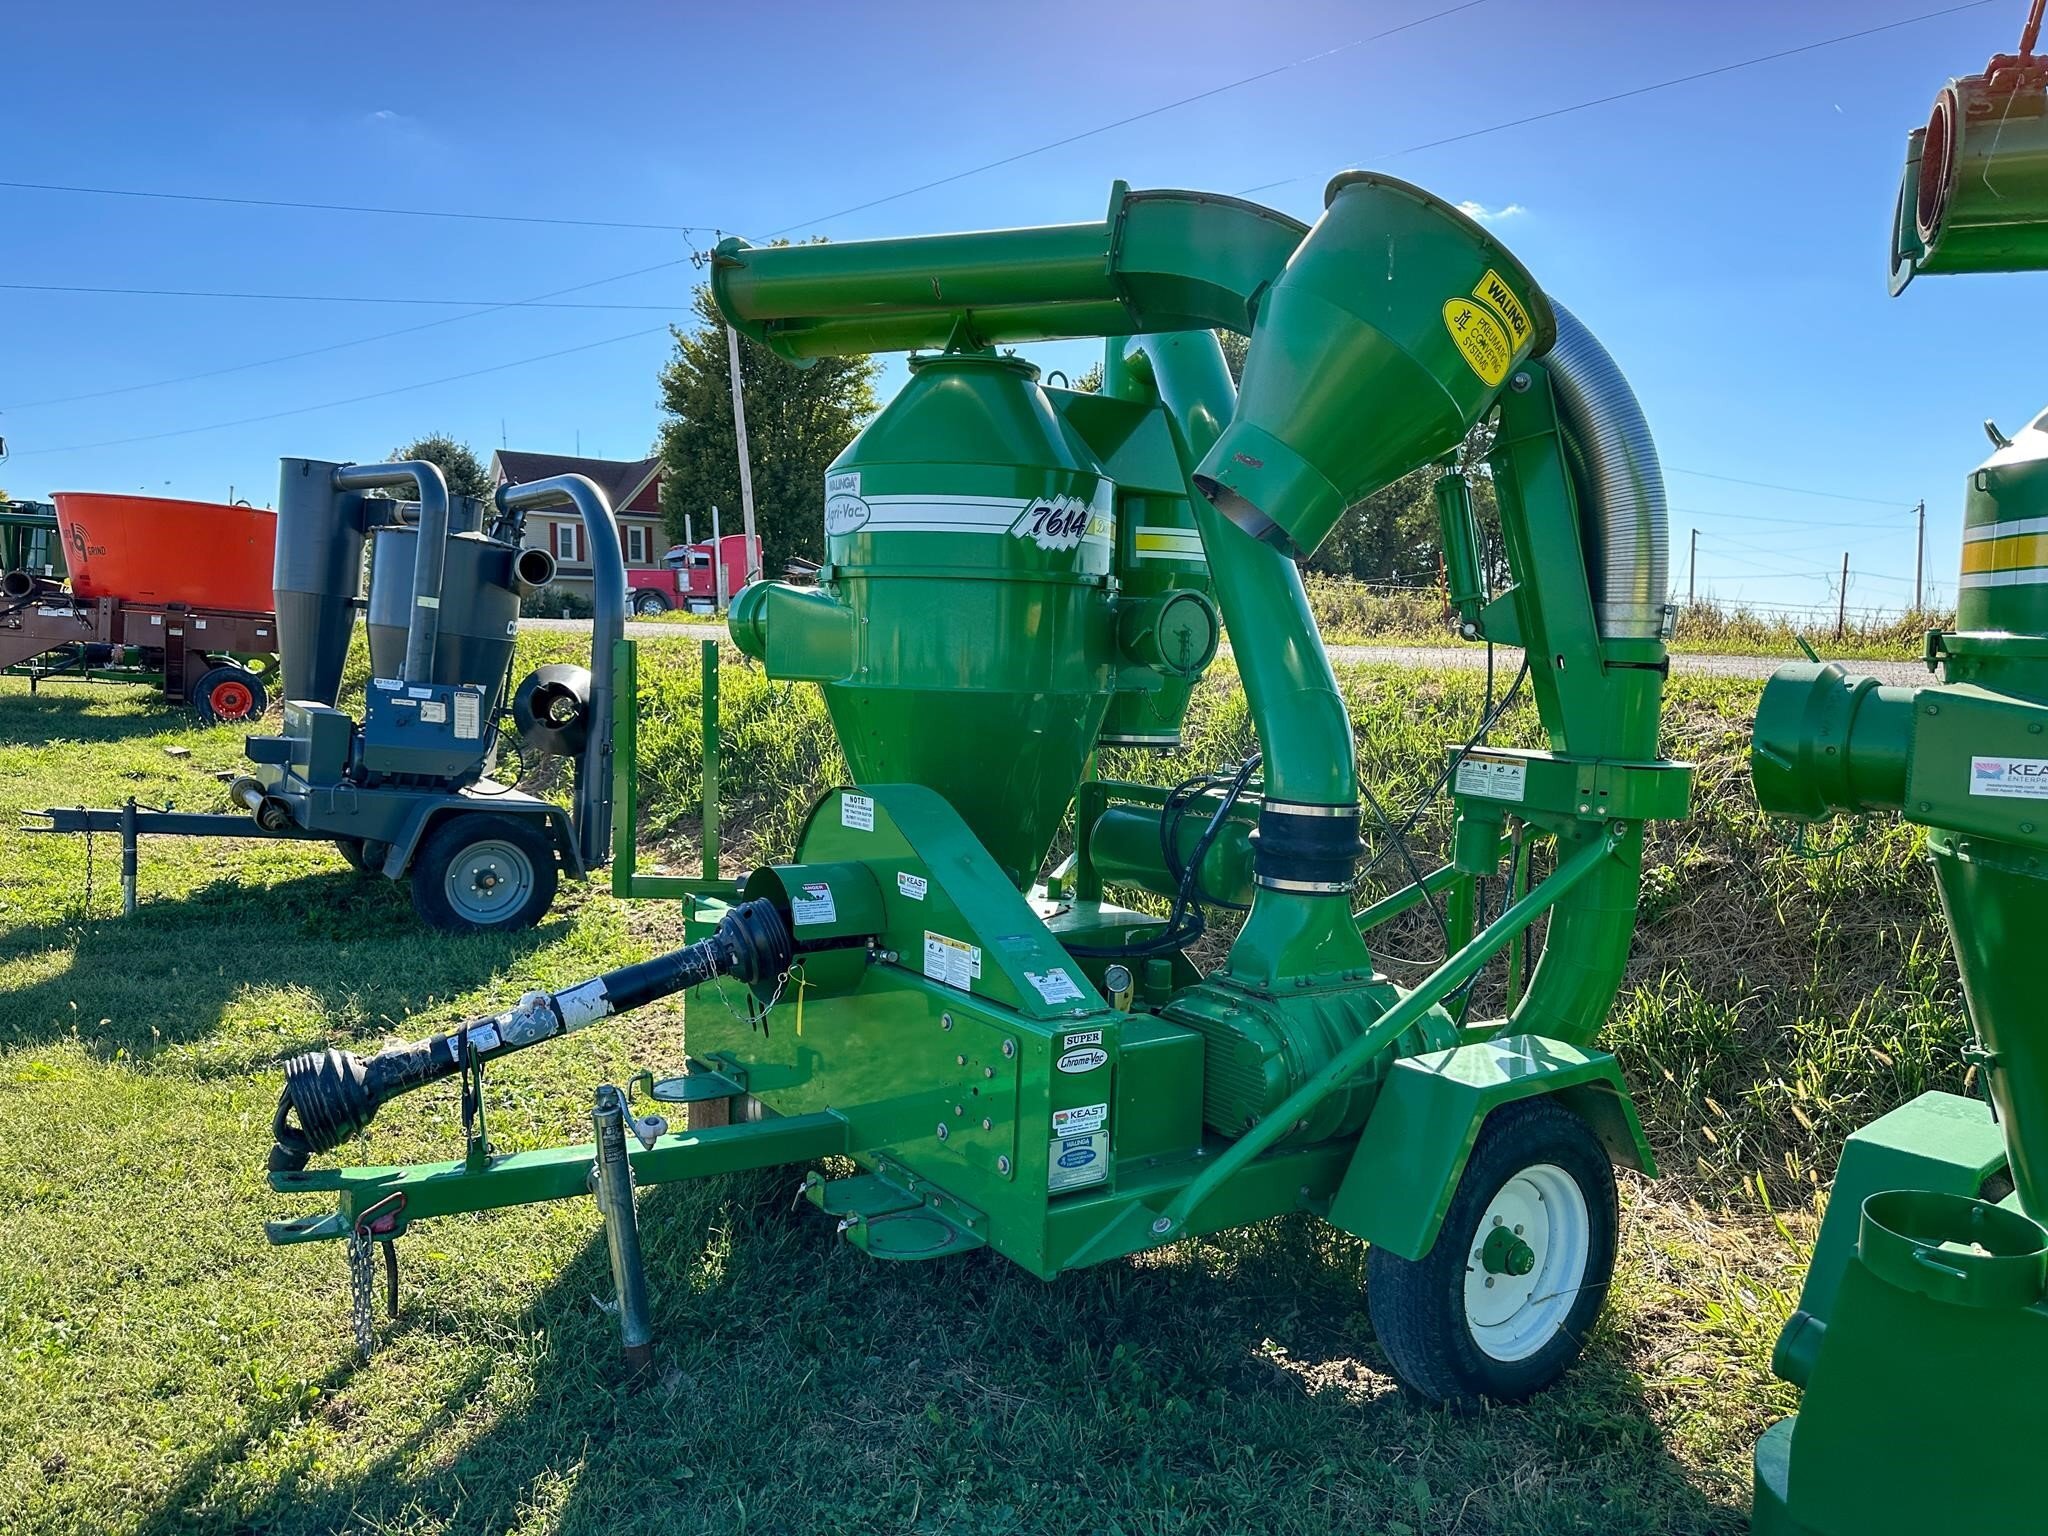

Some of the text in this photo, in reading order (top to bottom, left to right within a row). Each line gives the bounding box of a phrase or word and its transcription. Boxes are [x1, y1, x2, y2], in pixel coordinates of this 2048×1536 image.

[1487, 280, 1528, 339] WALINGA
[1463, 336, 1489, 371] SYSTEMS
[1477, 317, 1507, 362] PNEUMATIC
[1032, 507, 1088, 538] 7614
[1066, 1033, 1100, 1045] SUPER
[1070, 1105, 1105, 1119] KEAST
